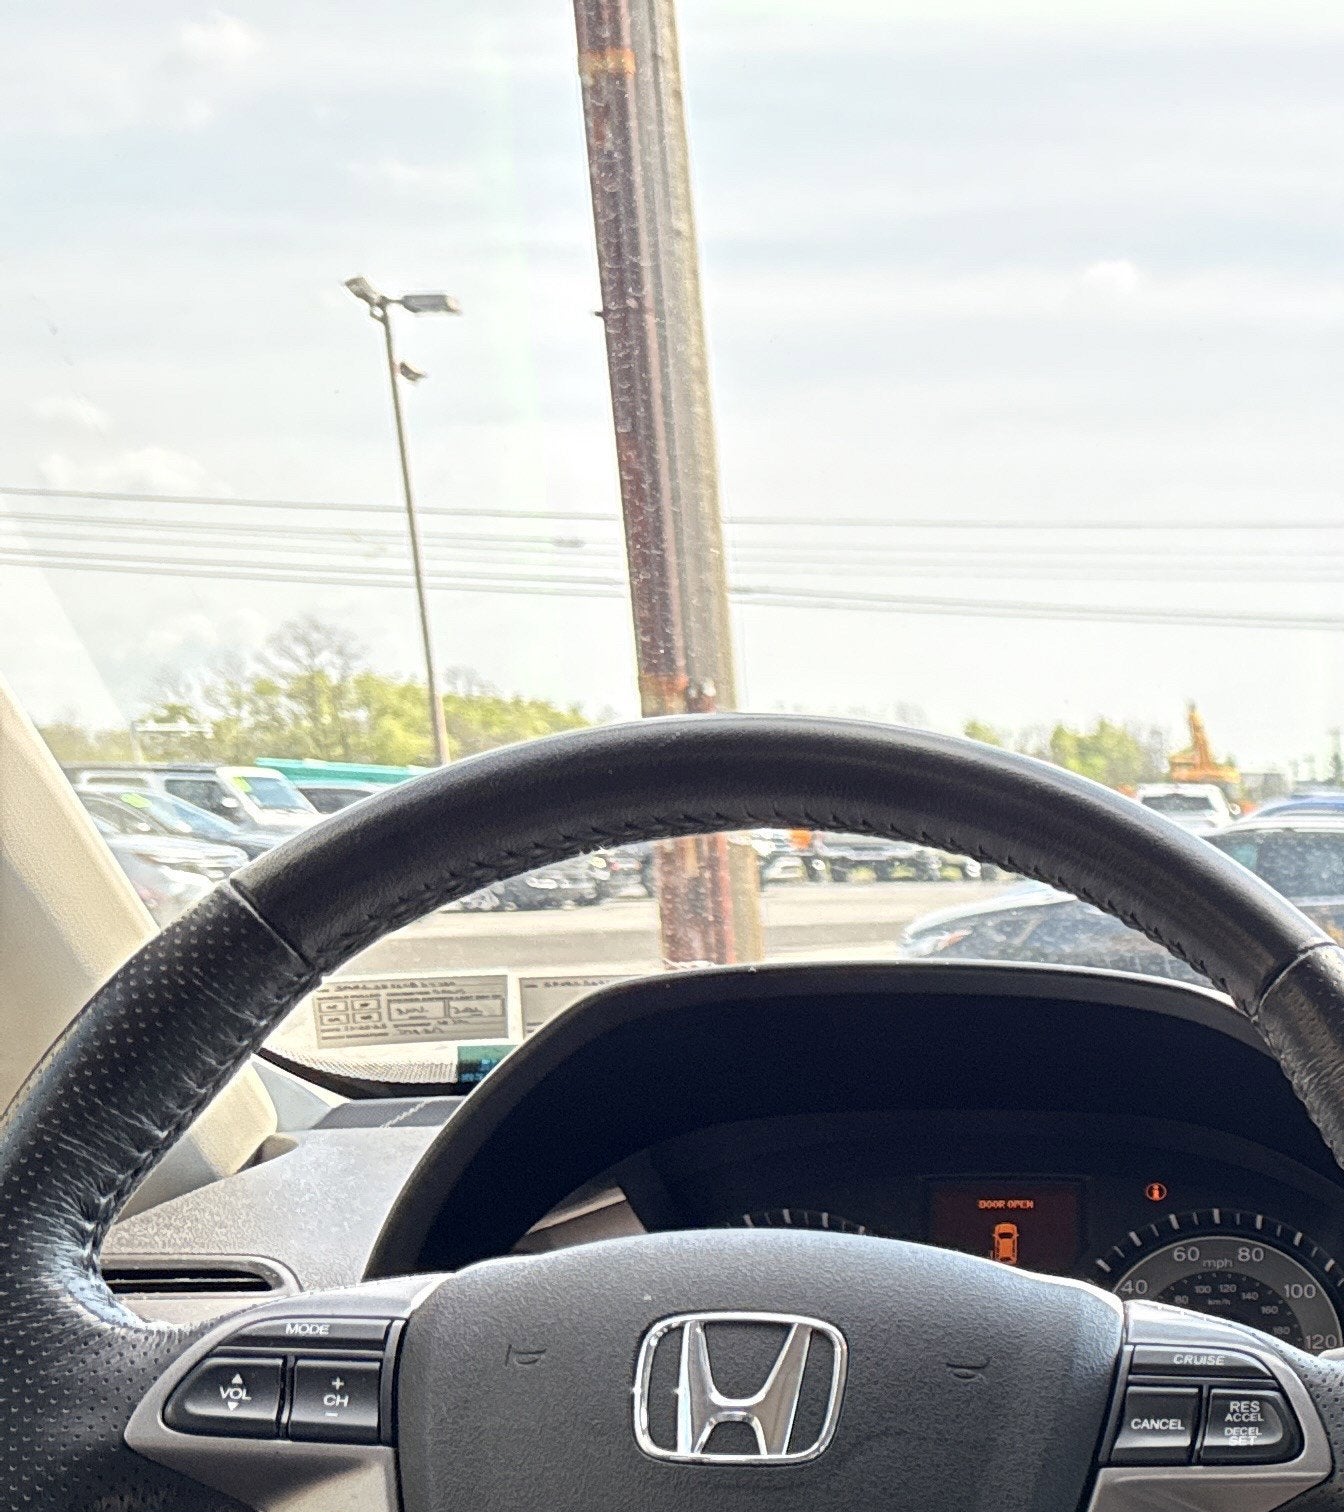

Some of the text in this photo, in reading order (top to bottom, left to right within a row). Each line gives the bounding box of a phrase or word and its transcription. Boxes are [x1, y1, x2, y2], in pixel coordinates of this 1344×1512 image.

[978, 1199, 1034, 1209] DOOR OPEN
[1173, 1246, 1200, 1262] 60
[1237, 1247, 1264, 1262] 80
[1202, 1258, 1234, 1270] mph
[1121, 1279, 1148, 1294] 40
[1219, 1284, 1237, 1293] 120
[1284, 1283, 1316, 1299] 100
[285, 1323, 330, 1335] MODE
[1305, 1333, 1338, 1350] 120
[1173, 1354, 1226, 1366] CRUISE
[219, 1386, 252, 1401] VOL
[323, 1394, 349, 1407] CH
[1229, 1401, 1260, 1413] RES
[1224, 1413, 1264, 1422] ACCEL
[1131, 1418, 1185, 1431] CANCEL
[1224, 1427, 1262, 1436] DECEL
[1229, 1436, 1257, 1446] SET
